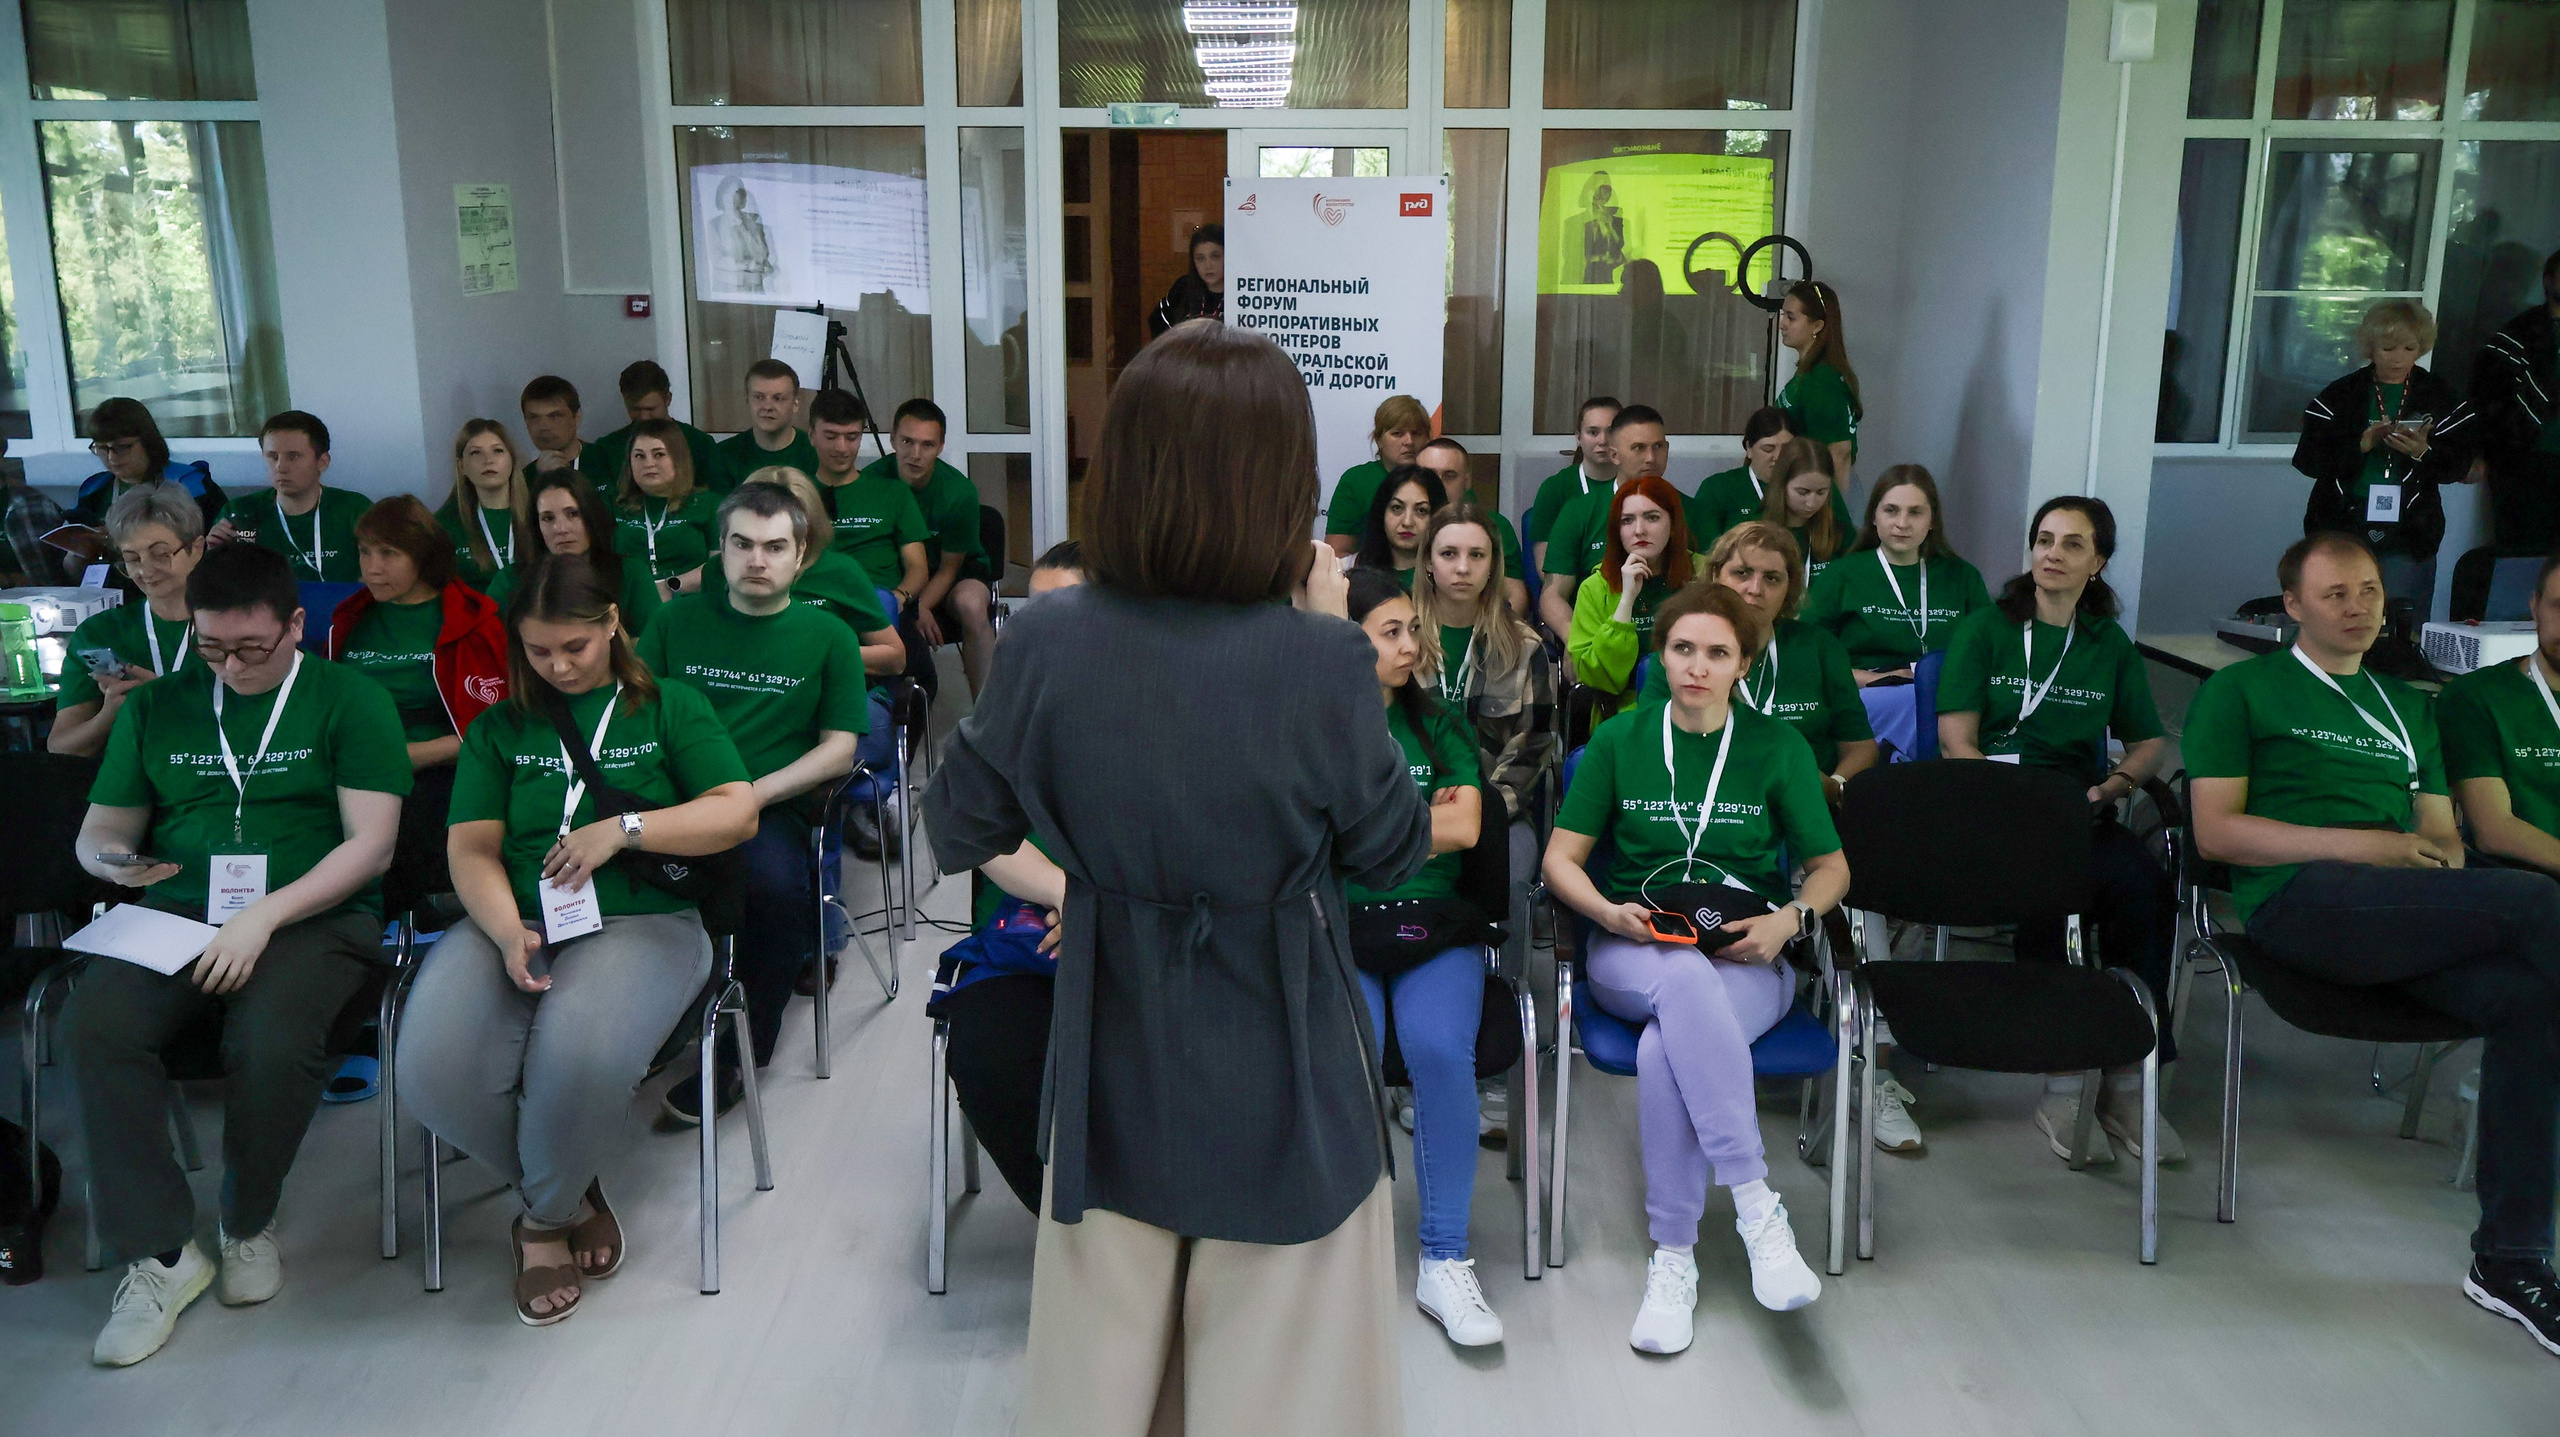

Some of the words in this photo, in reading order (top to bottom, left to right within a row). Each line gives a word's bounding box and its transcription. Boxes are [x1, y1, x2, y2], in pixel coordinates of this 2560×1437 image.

[1236, 277, 1370, 295] РЕГИОНАЛЬНЫЙ
[1236, 294, 1298, 311] ФОРУМ
[1236, 314, 1380, 332] КОРПОРАТИВНЫХ
[1264, 333, 1341, 349] ОНТЕРОВ
[1292, 353, 1389, 371] УРАЛЬСКОЙ
[1328, 373, 1397, 390] ДОРОГИ
[685, 665, 702, 675] 55°
[702, 667, 746, 680] 123'744"
[748, 673, 765, 683] 61°
[1990, 675, 2006, 686] 55°
[170, 752, 189, 765] 55°
[264, 748, 313, 763] 329'170"
[514, 755, 536, 765] 55°
[608, 741, 658, 759] 329'170"
[2514, 747, 2532, 757] 55°
[2534, 748, 2560, 758] 123'7
[1622, 799, 1642, 810] 55°
